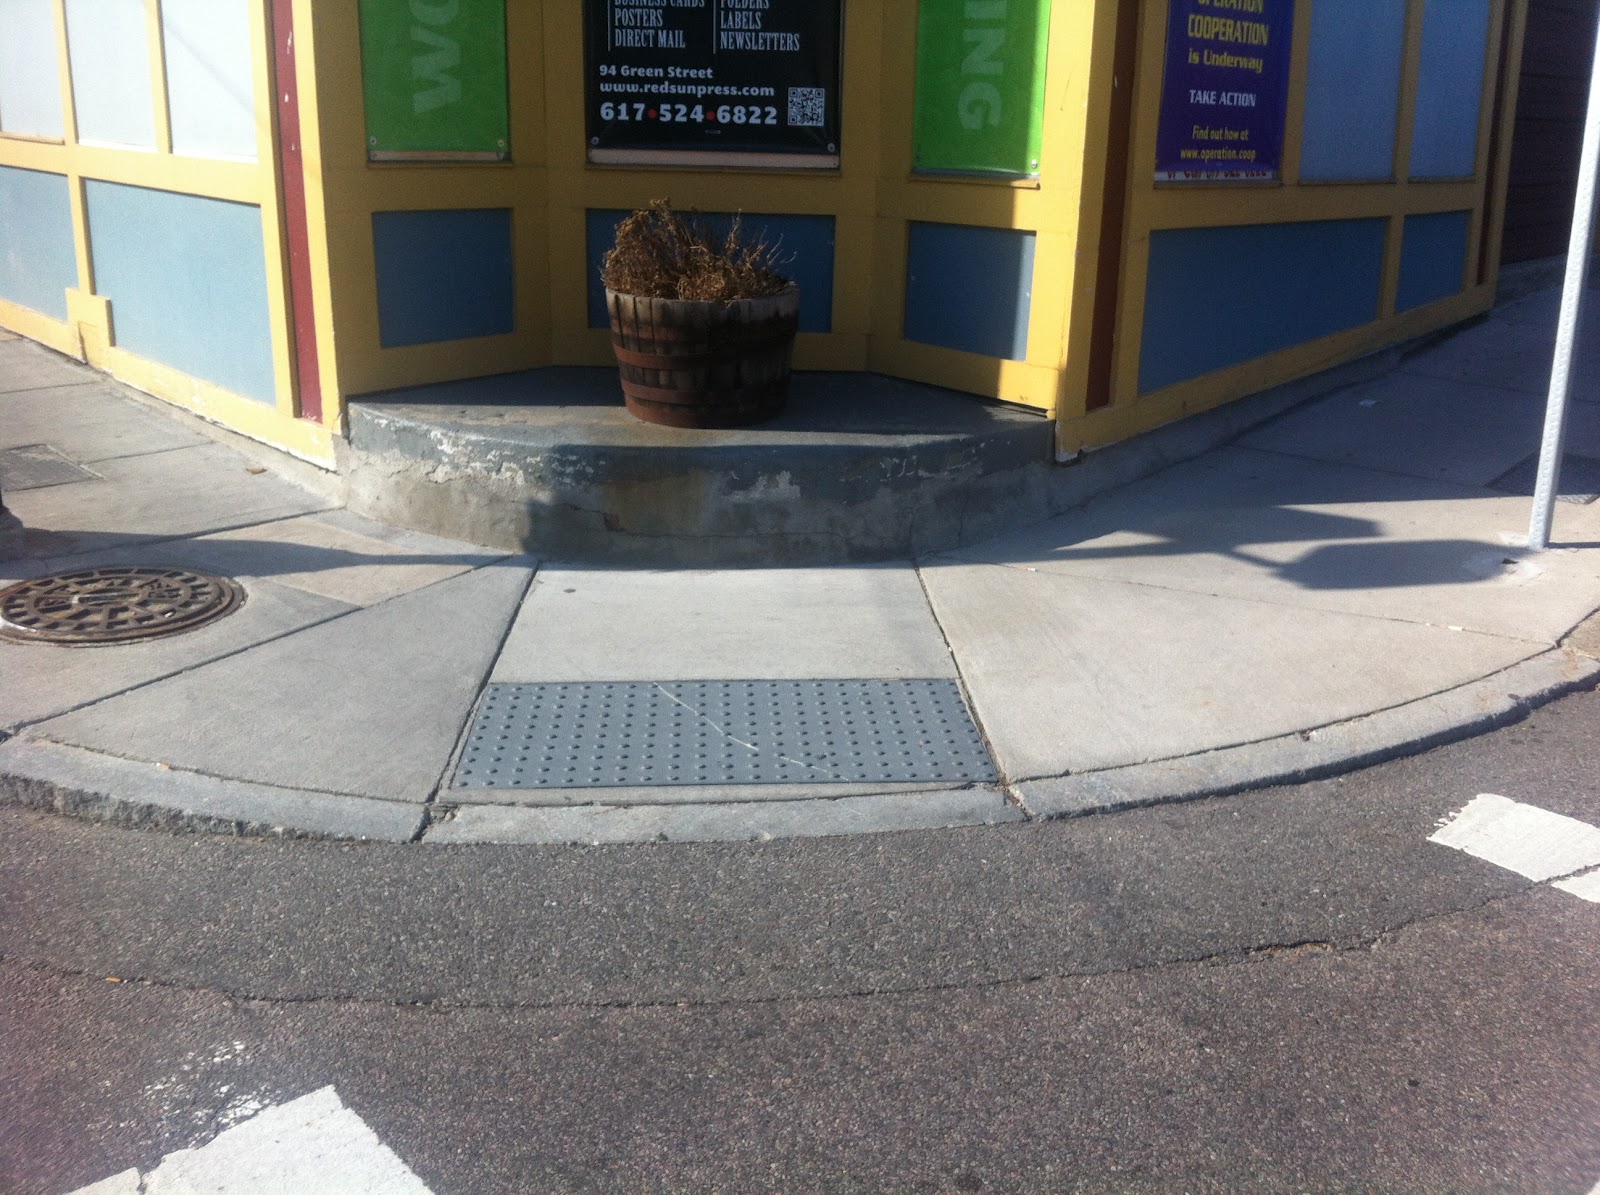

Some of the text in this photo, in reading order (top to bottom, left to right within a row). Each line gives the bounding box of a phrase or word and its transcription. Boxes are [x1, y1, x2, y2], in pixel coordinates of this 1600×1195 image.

[614, 8, 663, 27] POSTERS
[720, 10, 762, 29] LABELS
[614, 28, 686, 48] DIRECT MAIL
[1187, 13, 1269, 46] COOPERATION
[720, 31, 800, 51] NEWSLETTERS
[1188, 47, 1264, 74] is Underway
[599, 65, 714, 78] 94 Green Street
[599, 80, 775, 98] www.redsunpress.com
[1189, 89, 1256, 107] TAKE ACTION
[1192, 124, 1249, 141] Find out how at
